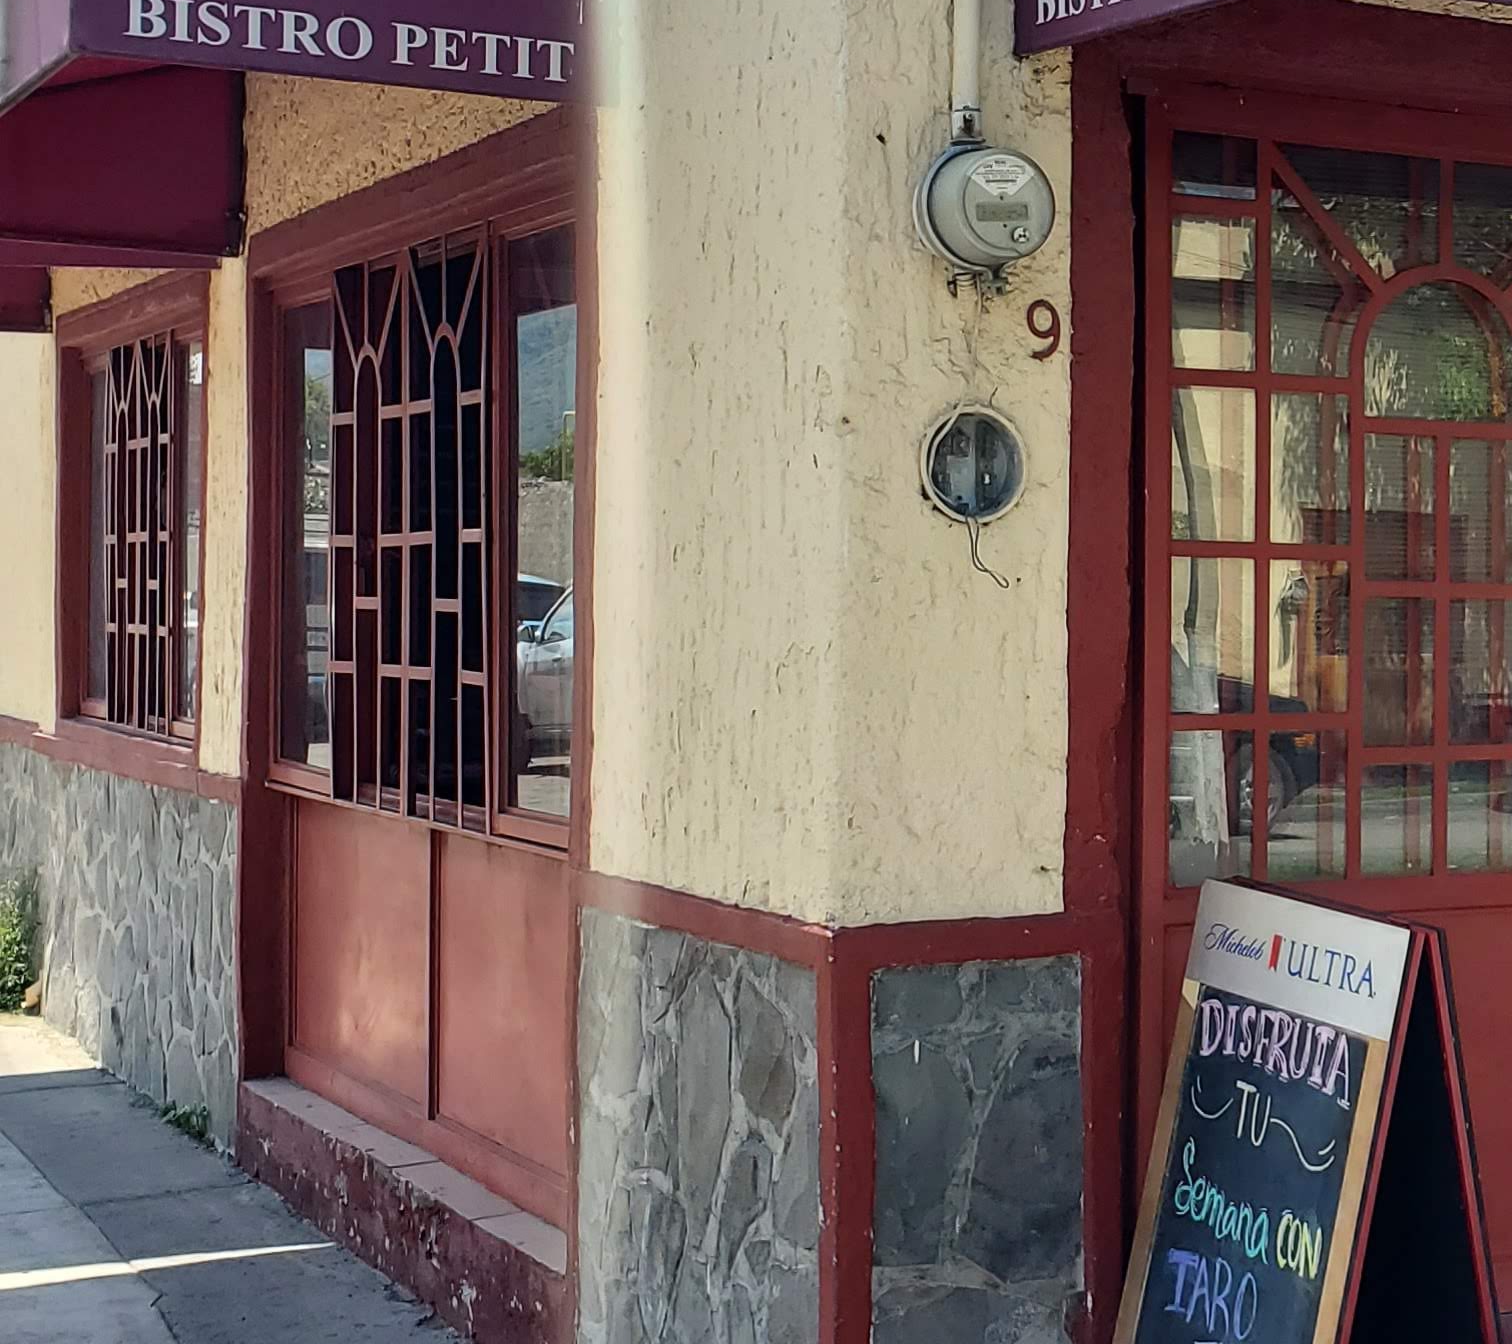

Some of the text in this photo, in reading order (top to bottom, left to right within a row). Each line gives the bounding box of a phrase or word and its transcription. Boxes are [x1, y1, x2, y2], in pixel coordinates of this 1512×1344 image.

[391, 21, 576, 83] PETIT
[1026, 299, 1061, 362] 9
[1287, 940, 1377, 1000] ULTRA
[1200, 999, 1351, 1111] DISFRUTA
[1236, 1079, 1272, 1147] TU
[1174, 1136, 1271, 1265] Semana
[1164, 1247, 1258, 1341] TARO
